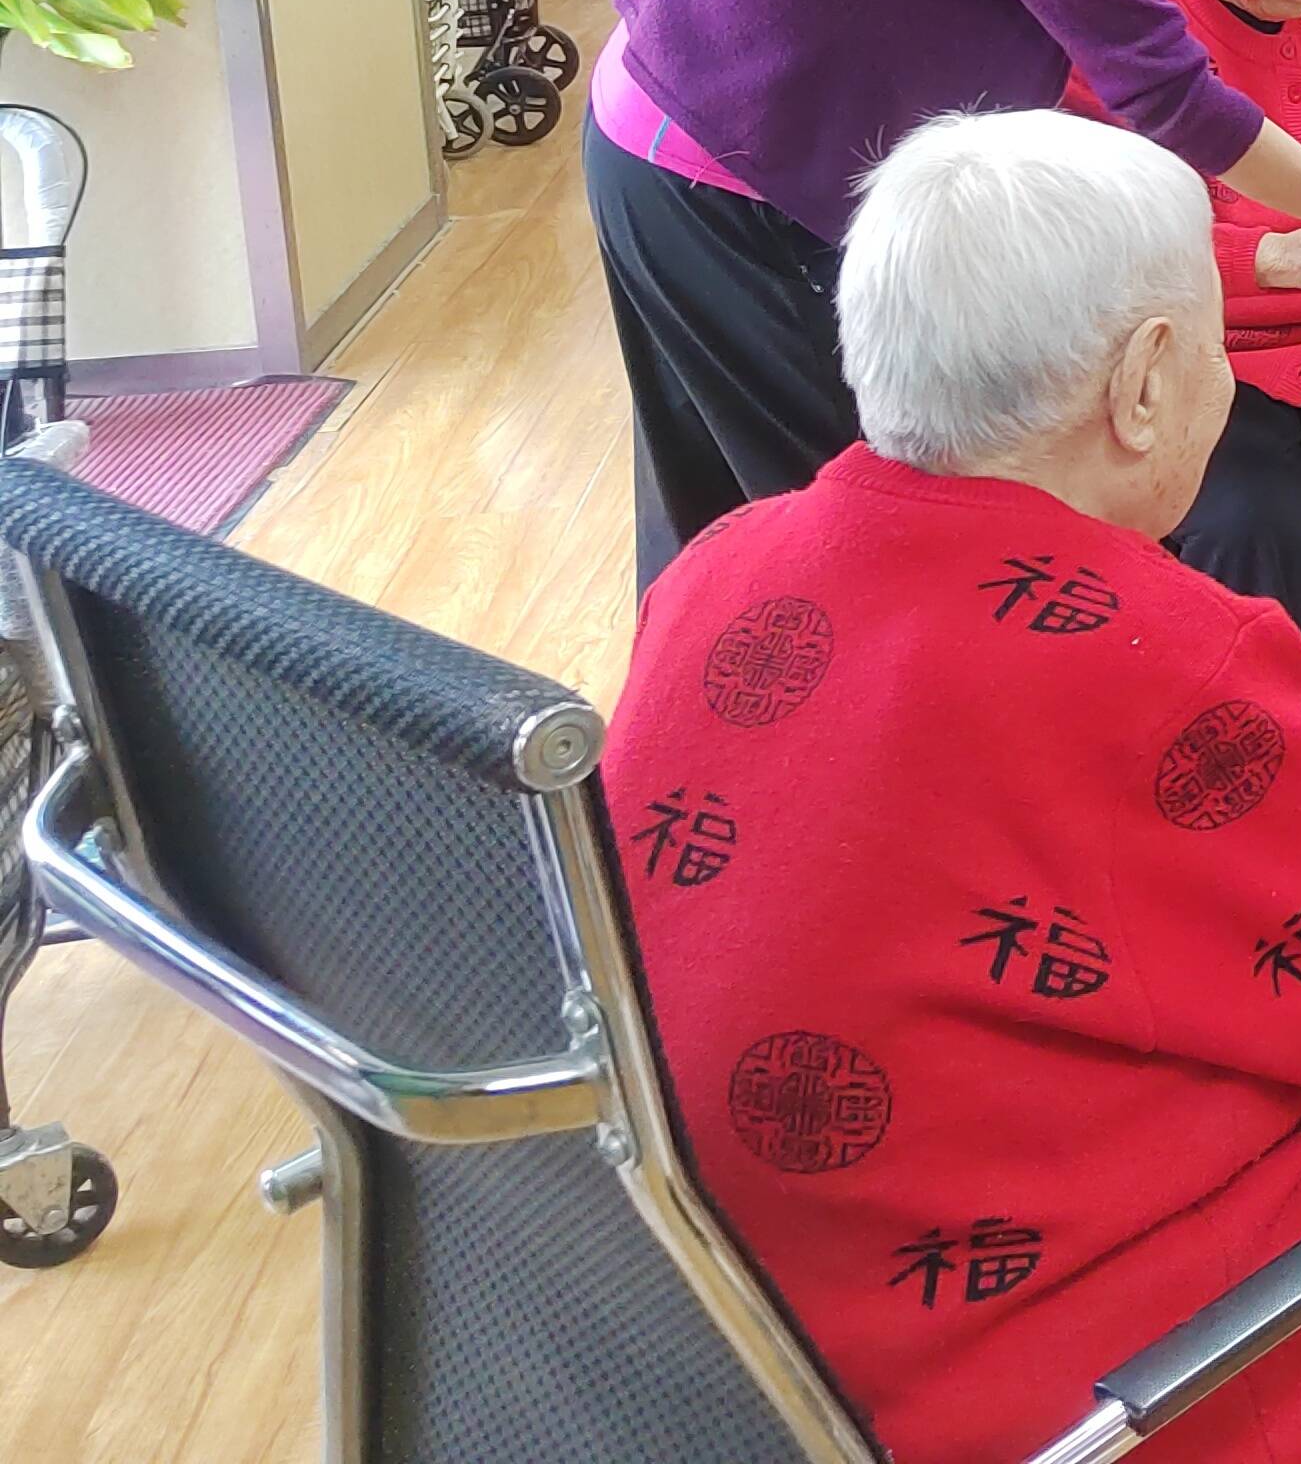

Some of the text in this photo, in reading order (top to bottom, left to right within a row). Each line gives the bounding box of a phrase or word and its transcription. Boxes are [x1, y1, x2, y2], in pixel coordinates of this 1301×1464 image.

[977, 554, 1121, 638] 福
[629, 786, 738, 888] 福
[957, 895, 1113, 1000] 福
[889, 1216, 1042, 1309] 福
